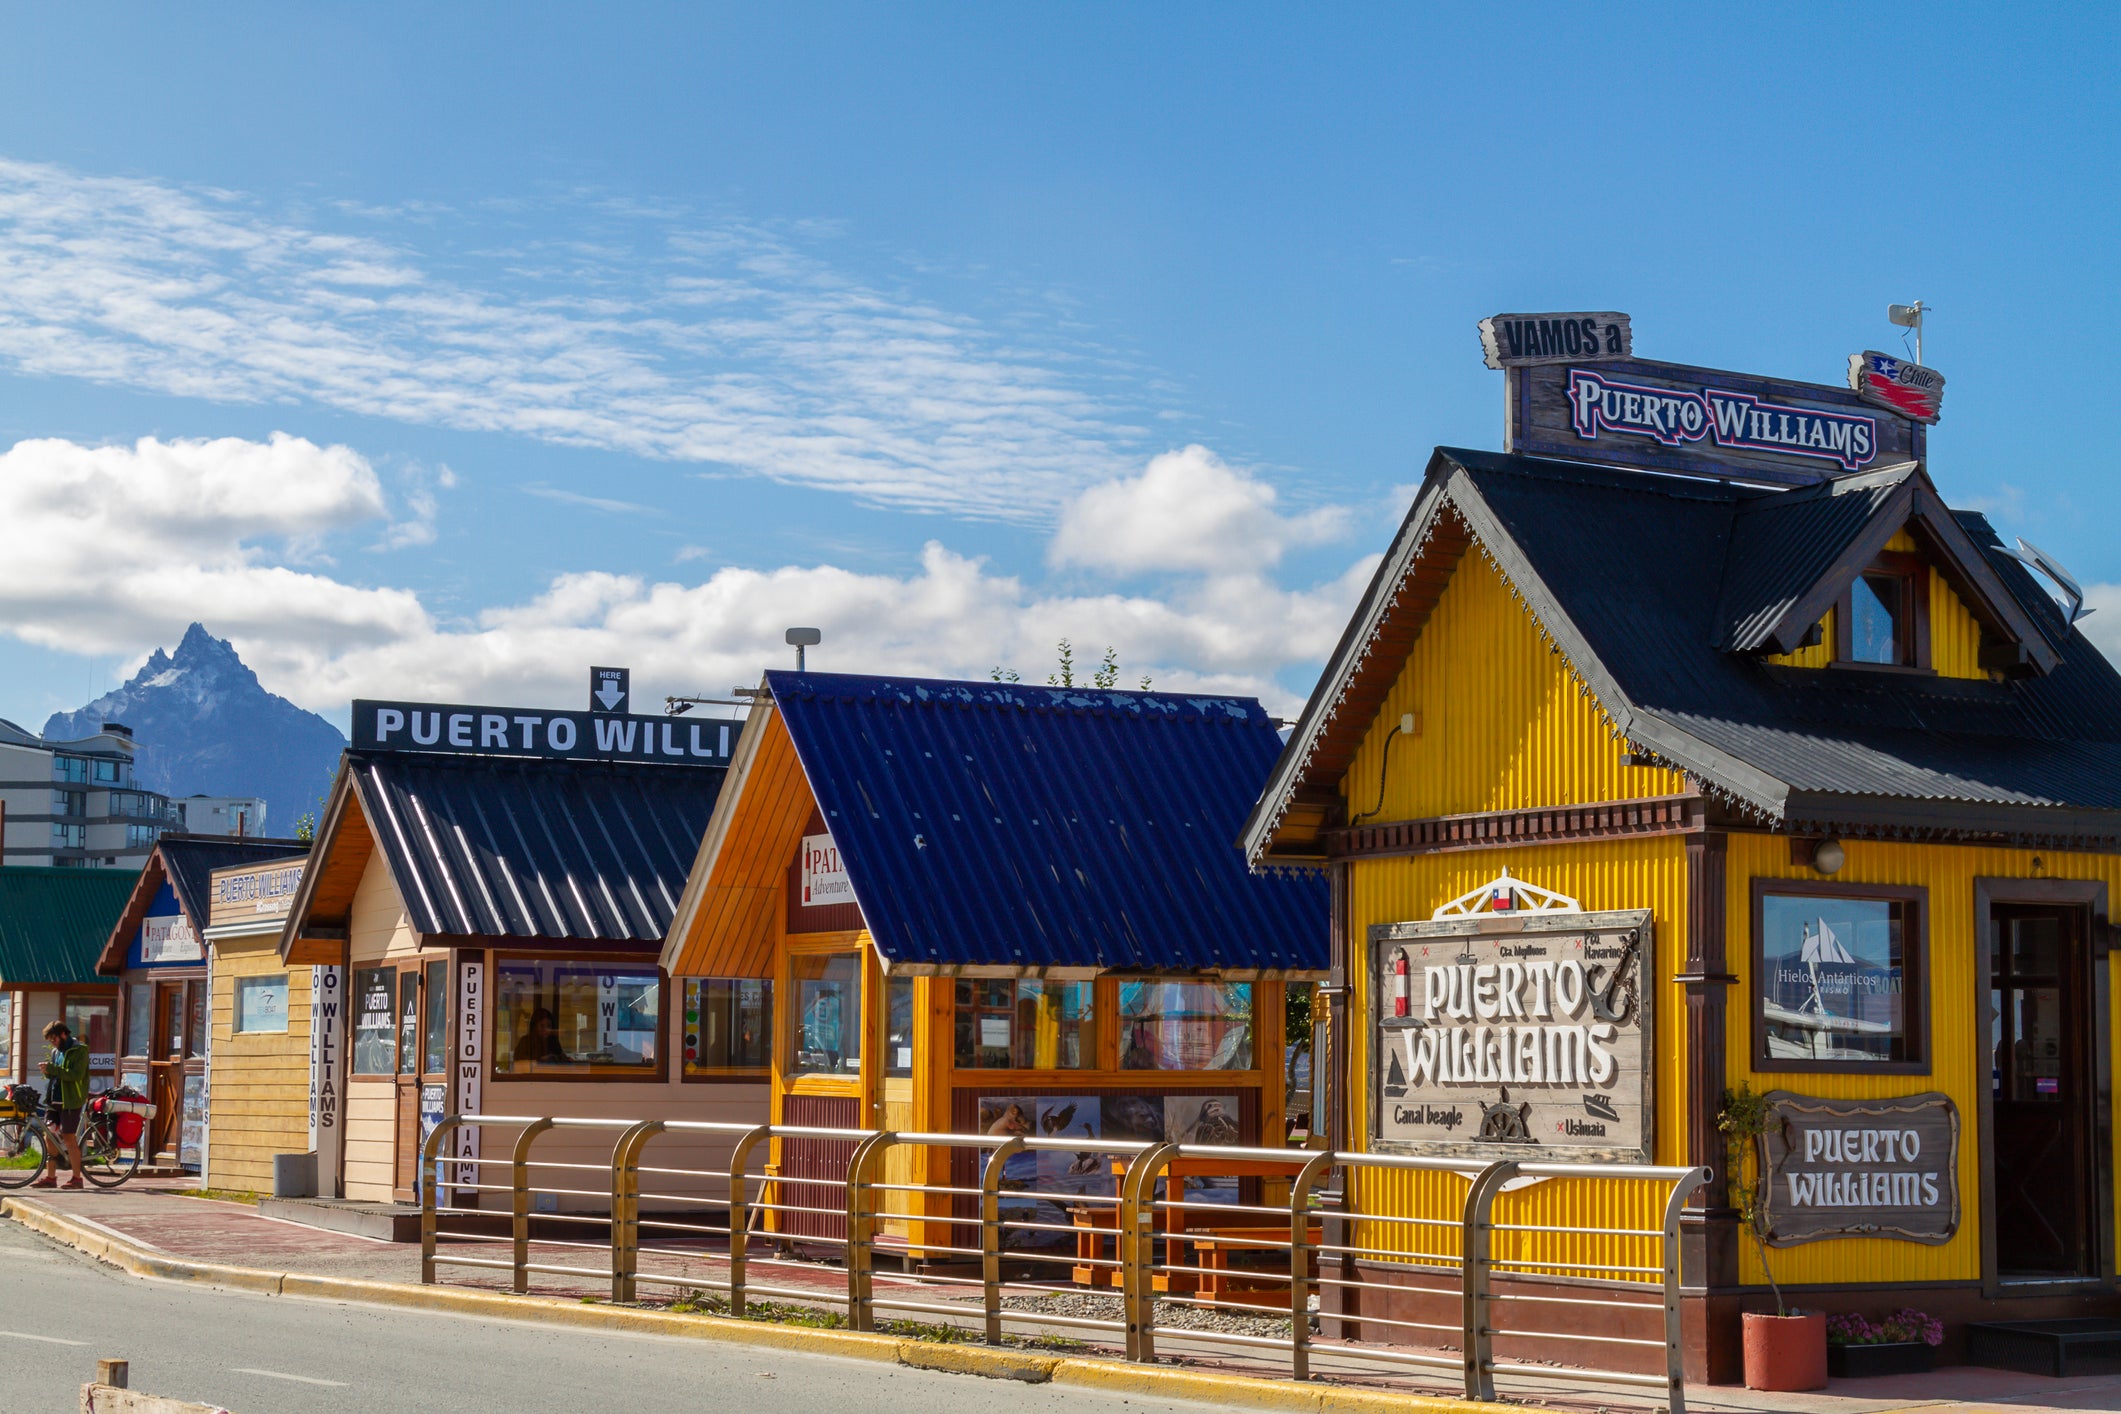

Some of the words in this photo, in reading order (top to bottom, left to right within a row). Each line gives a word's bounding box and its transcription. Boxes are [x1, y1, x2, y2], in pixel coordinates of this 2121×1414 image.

[1505, 318, 1599, 357] VAMOS
[1606, 323, 1622, 353] a
[1900, 363, 1934, 389] Chile
[1576, 378, 1702, 433] PUERTO
[1711, 398, 1870, 458] WILLIAMS
[600, 671, 621, 680] HERE
[376, 708, 577, 751] PUERTO
[594, 718, 729, 758] WILLI
[220, 874, 256, 904] PUERTO
[258, 867, 303, 898] WILLIAMS
[812, 878, 849, 896] Adventure
[151, 926, 195, 941] PATAGON
[1424, 959, 1585, 1020] PUERTO
[1778, 969, 1814, 983] Hielos
[1818, 971, 1877, 986] Antárticos
[365, 992, 388, 1010] PUERTO
[464, 967, 477, 1057] PUERTO
[362, 1011, 391, 1029] WILLIAMS
[320, 1002, 337, 1127] WILLIAMS
[1401, 1024, 1616, 1085] WILLIAMS
[460, 1066, 478, 1187] WILIAMS
[1394, 1105, 1424, 1126] Canal
[1426, 1105, 1462, 1131] beagle
[1566, 1118, 1606, 1137] Ushuaia
[1804, 1129, 1920, 1163] PUERTO
[1786, 1172, 1938, 1207] WILLIAMS
